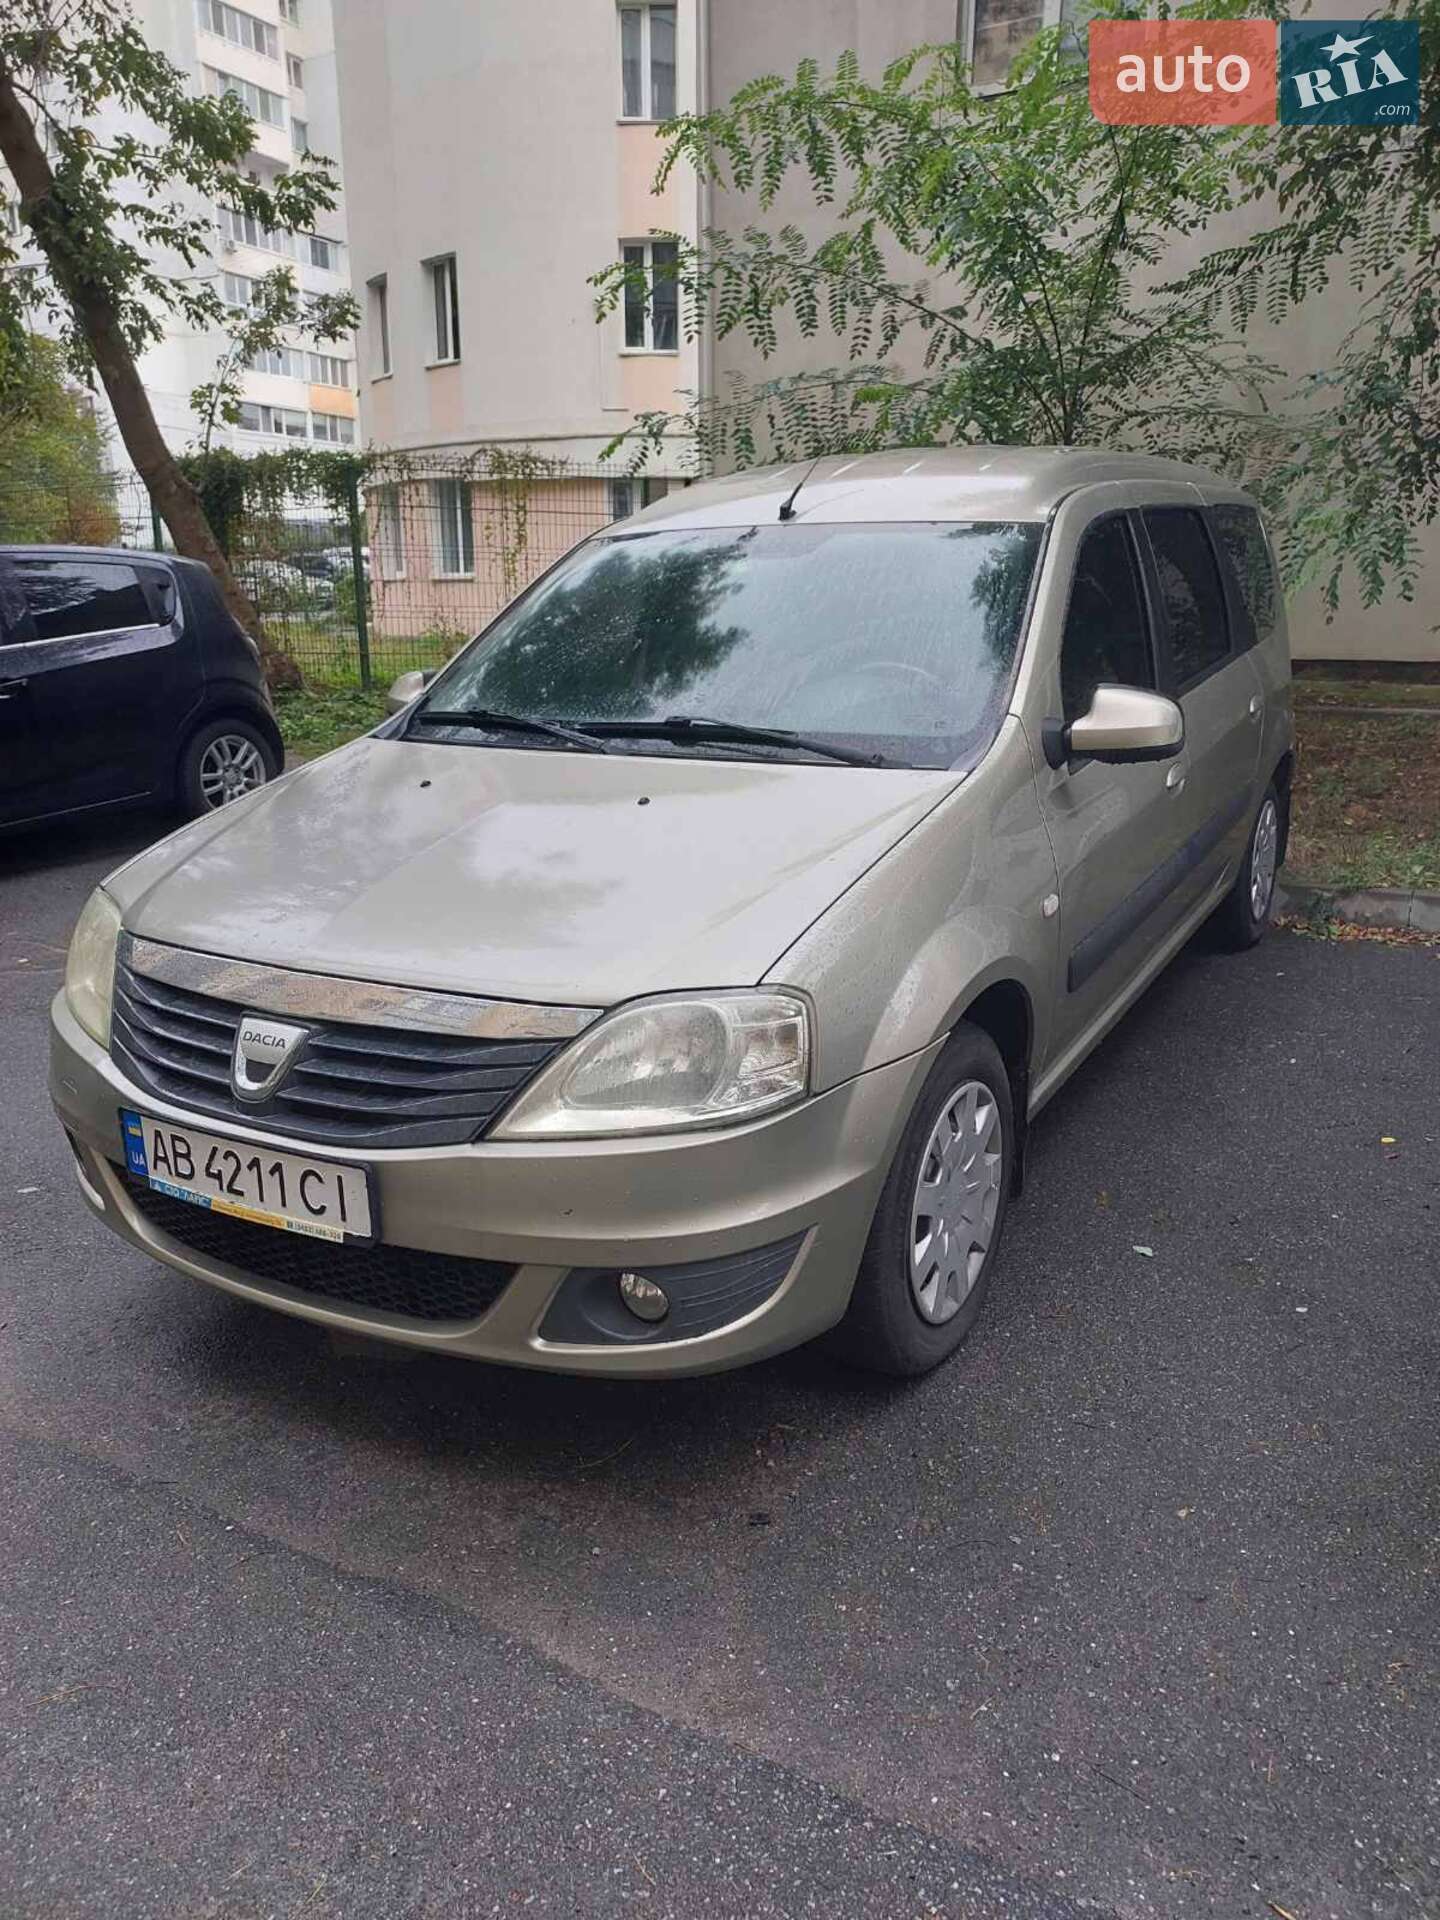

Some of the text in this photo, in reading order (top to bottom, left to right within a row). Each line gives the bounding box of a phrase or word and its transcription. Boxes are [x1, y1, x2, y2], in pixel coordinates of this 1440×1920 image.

[243, 1030, 286, 1048] DACIA
[131, 1151, 146, 1166] UA
[153, 1129, 195, 1180] AB
[204, 1146, 287, 1208] 4211
[299, 1168, 347, 1222] CI
